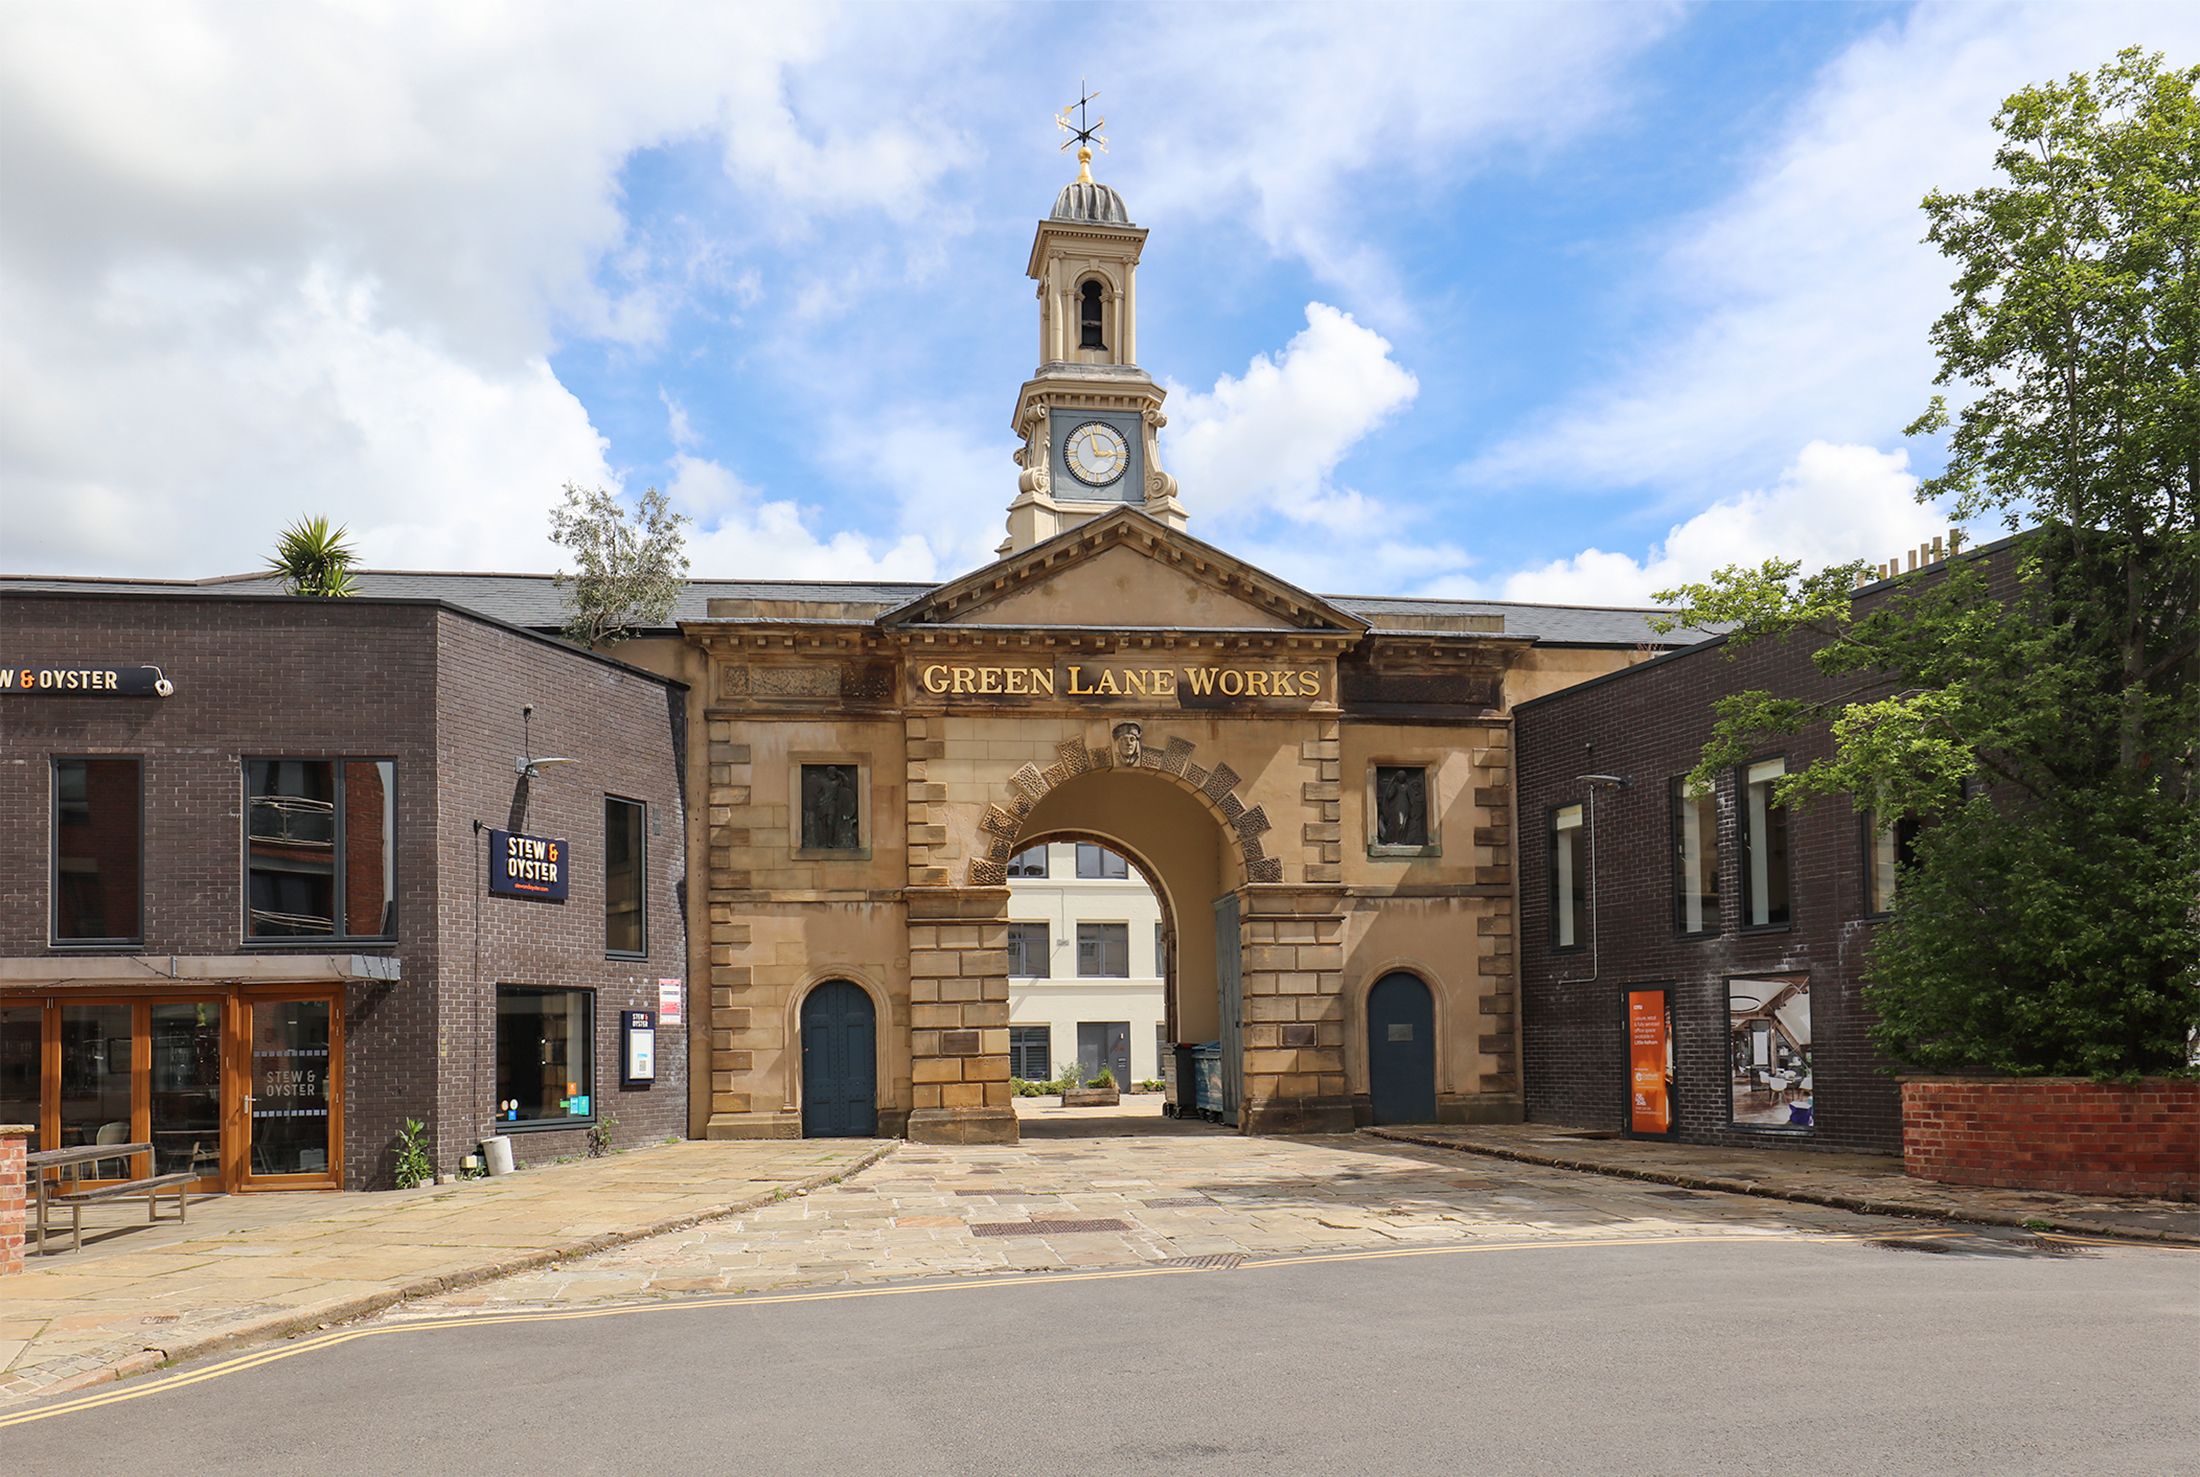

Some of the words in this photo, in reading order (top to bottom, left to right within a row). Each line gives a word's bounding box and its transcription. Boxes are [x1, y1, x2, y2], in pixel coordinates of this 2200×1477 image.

[20, 669, 35, 689] &
[39, 670, 118, 690] OYSTER
[923, 665, 1054, 694] GREEN
[1067, 666, 1175, 695] LANE
[1183, 667, 1320, 696] WORKS
[508, 837, 546, 860] STEW
[549, 843, 559, 862] &
[508, 858, 558, 882] OYSTER
[632, 1020, 649, 1028] OYSTER
[267, 1071, 303, 1083] STEW
[307, 1070, 316, 1082] &
[266, 1084, 315, 1097] OYSTER
